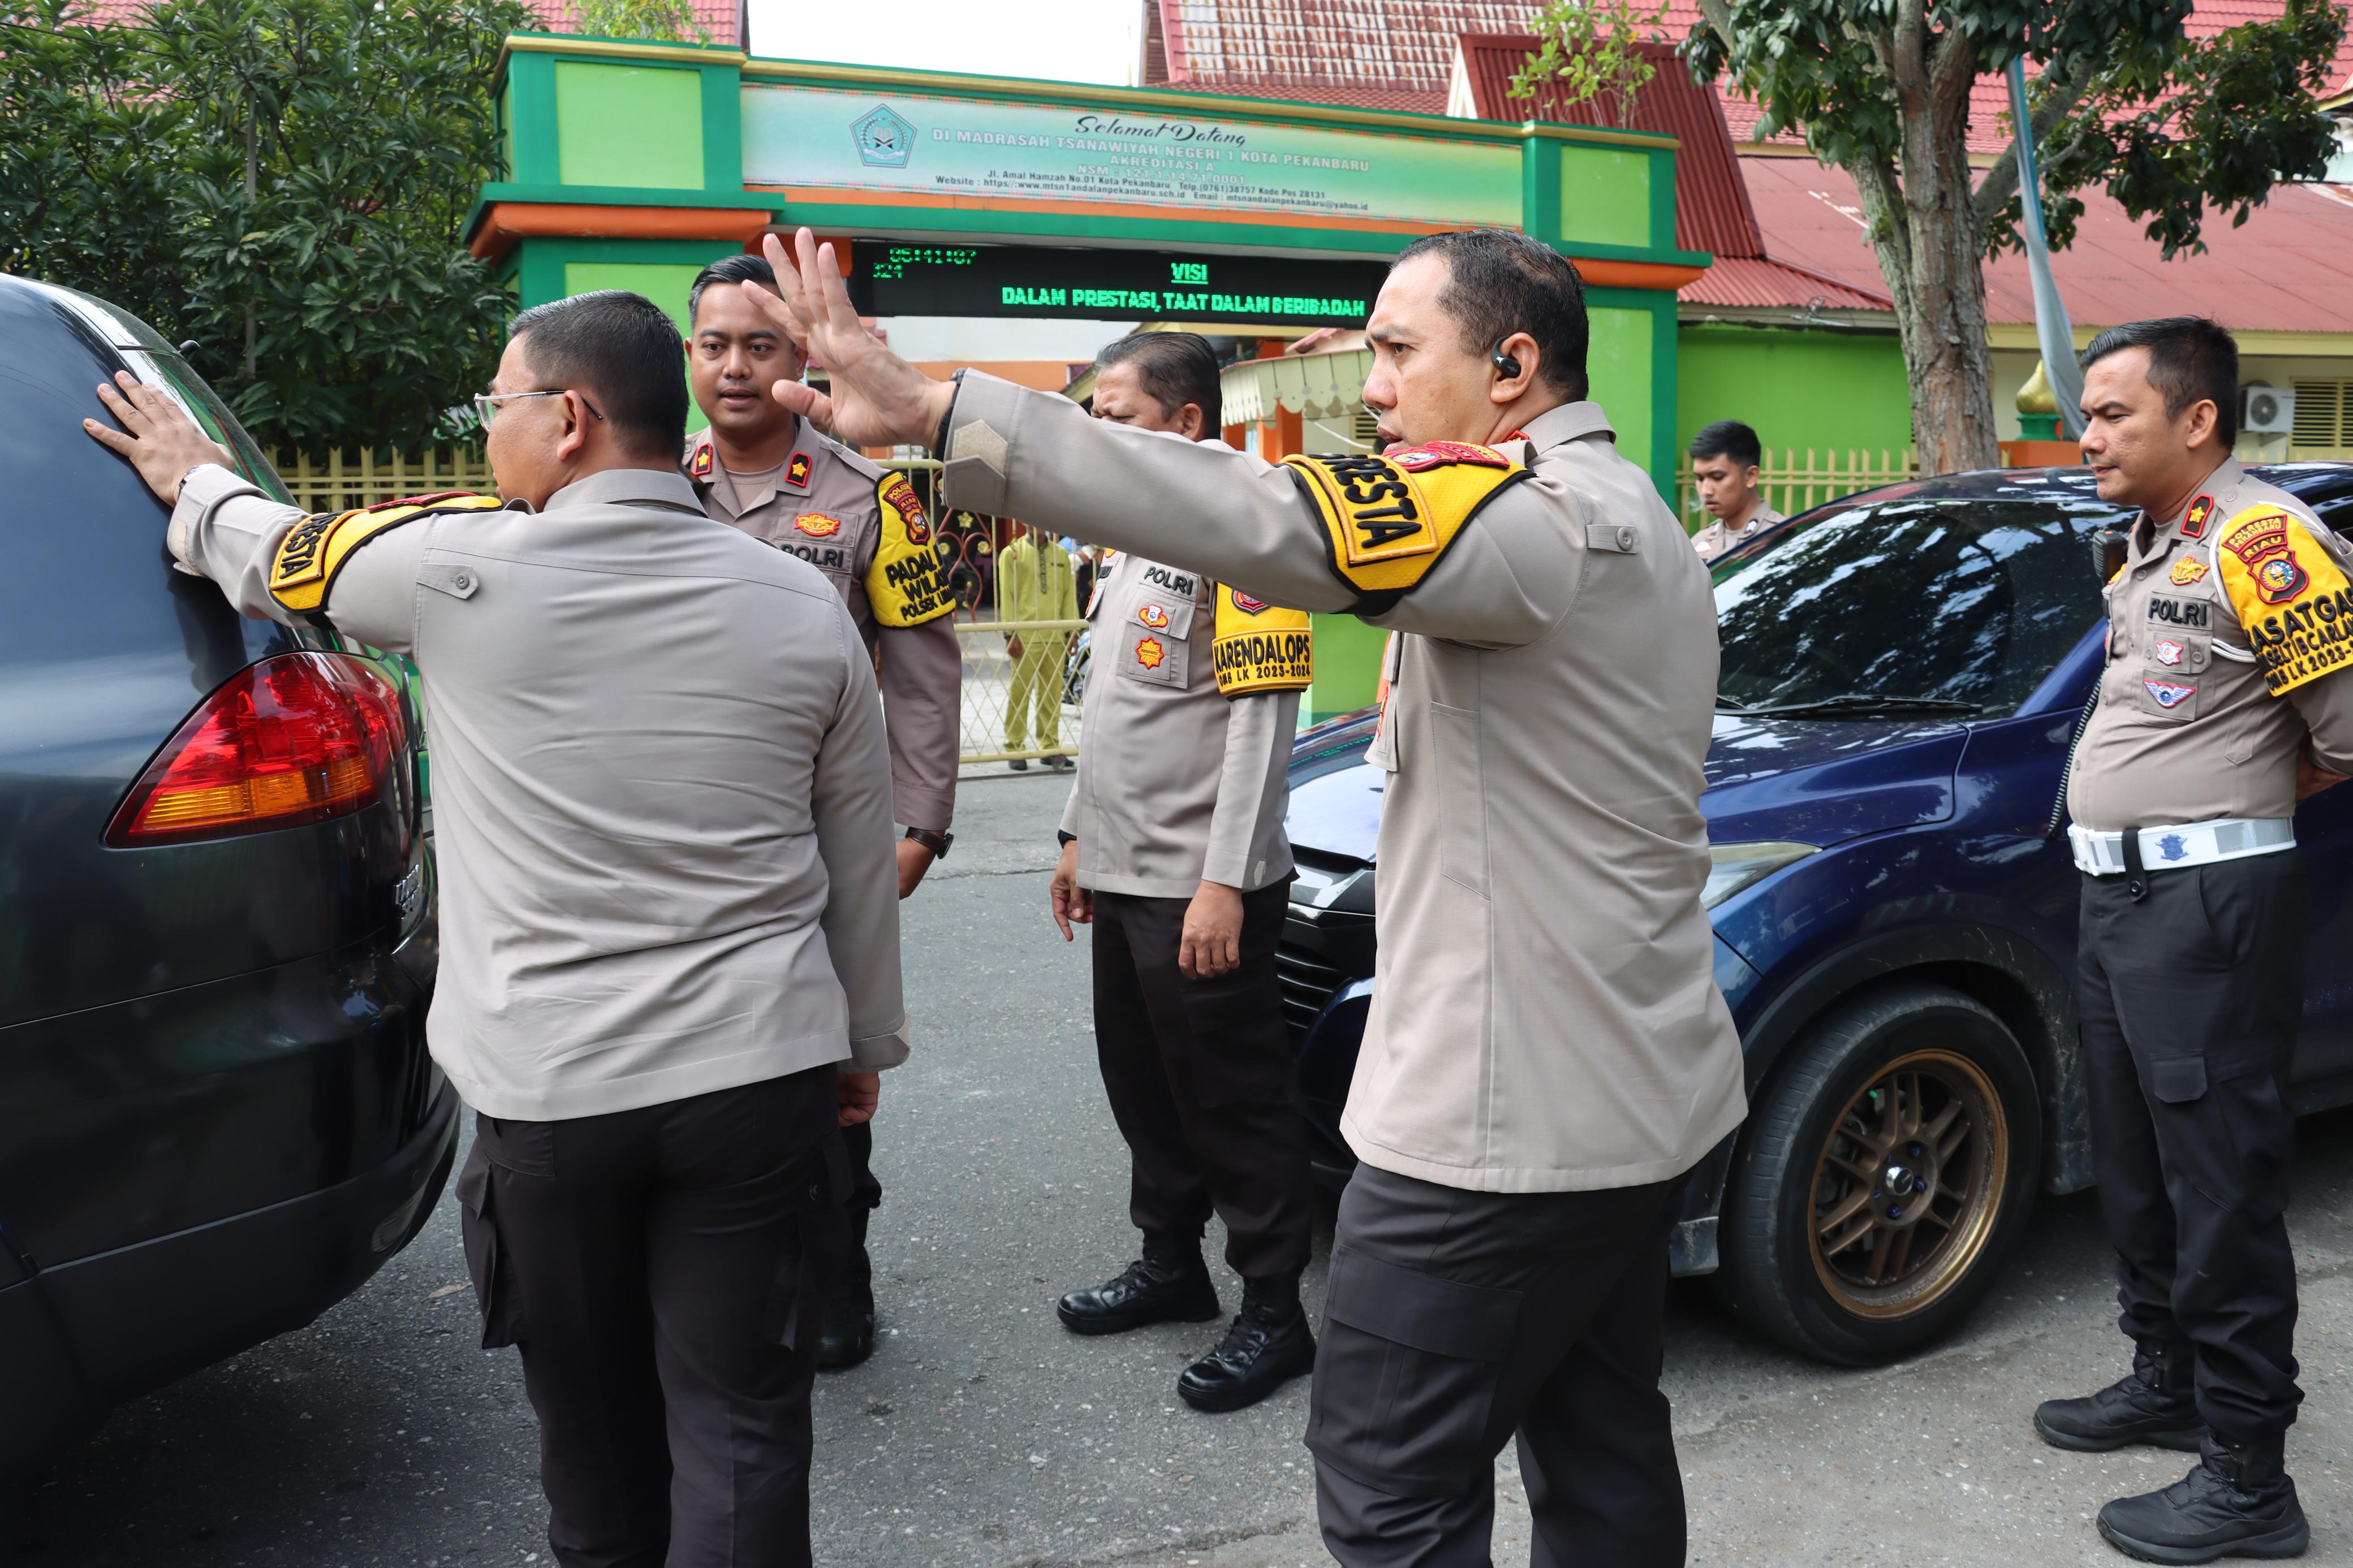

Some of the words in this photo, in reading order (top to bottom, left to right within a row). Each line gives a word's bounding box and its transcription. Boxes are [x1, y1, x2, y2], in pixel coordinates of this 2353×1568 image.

[1075, 116, 1171, 138] Selamat
[1171, 123, 1247, 148] Datang
[932, 128, 950, 141] DI
[956, 129, 1050, 148] MADRASAH
[1056, 136, 1158, 155] TSANAWIYAH
[1165, 145, 1221, 160] NEGERI
[1226, 150, 1235, 161] 1
[1240, 150, 1278, 164] KOTA
[1283, 153, 1369, 171] PEKANBARU
[1109, 154, 1199, 171] AKREDITASI
[1205, 162, 1214, 171] A
[1077, 164, 1109, 175] NSM
[935, 175, 974, 186] Website
[1193, 191, 1218, 200] Email
[1002, 171, 1025, 180] Amal
[1029, 172, 1066, 182] Hamzah
[1098, 176, 1119, 185] Kota
[1122, 178, 1170, 188] Pekanbaru
[1259, 187, 1279, 196] Kode
[1282, 189, 1296, 197] Pos
[1299, 189, 1325, 198] 28131
[1171, 262, 1208, 282] VISI
[1002, 287, 1066, 306] DALAM
[1072, 288, 1162, 312] PRESTASI,
[1162, 292, 1209, 310] TAAT
[1211, 295, 1270, 313] DALAM
[2228, 517, 2281, 546] POLRESTA
[2244, 535, 2282, 558] RIAU
[1144, 565, 1193, 595] POLRI
[2148, 598, 2207, 627] POLRI
[1214, 633, 1311, 674] KARENDALOPS
[1256, 663, 1311, 679] 2023-2024
